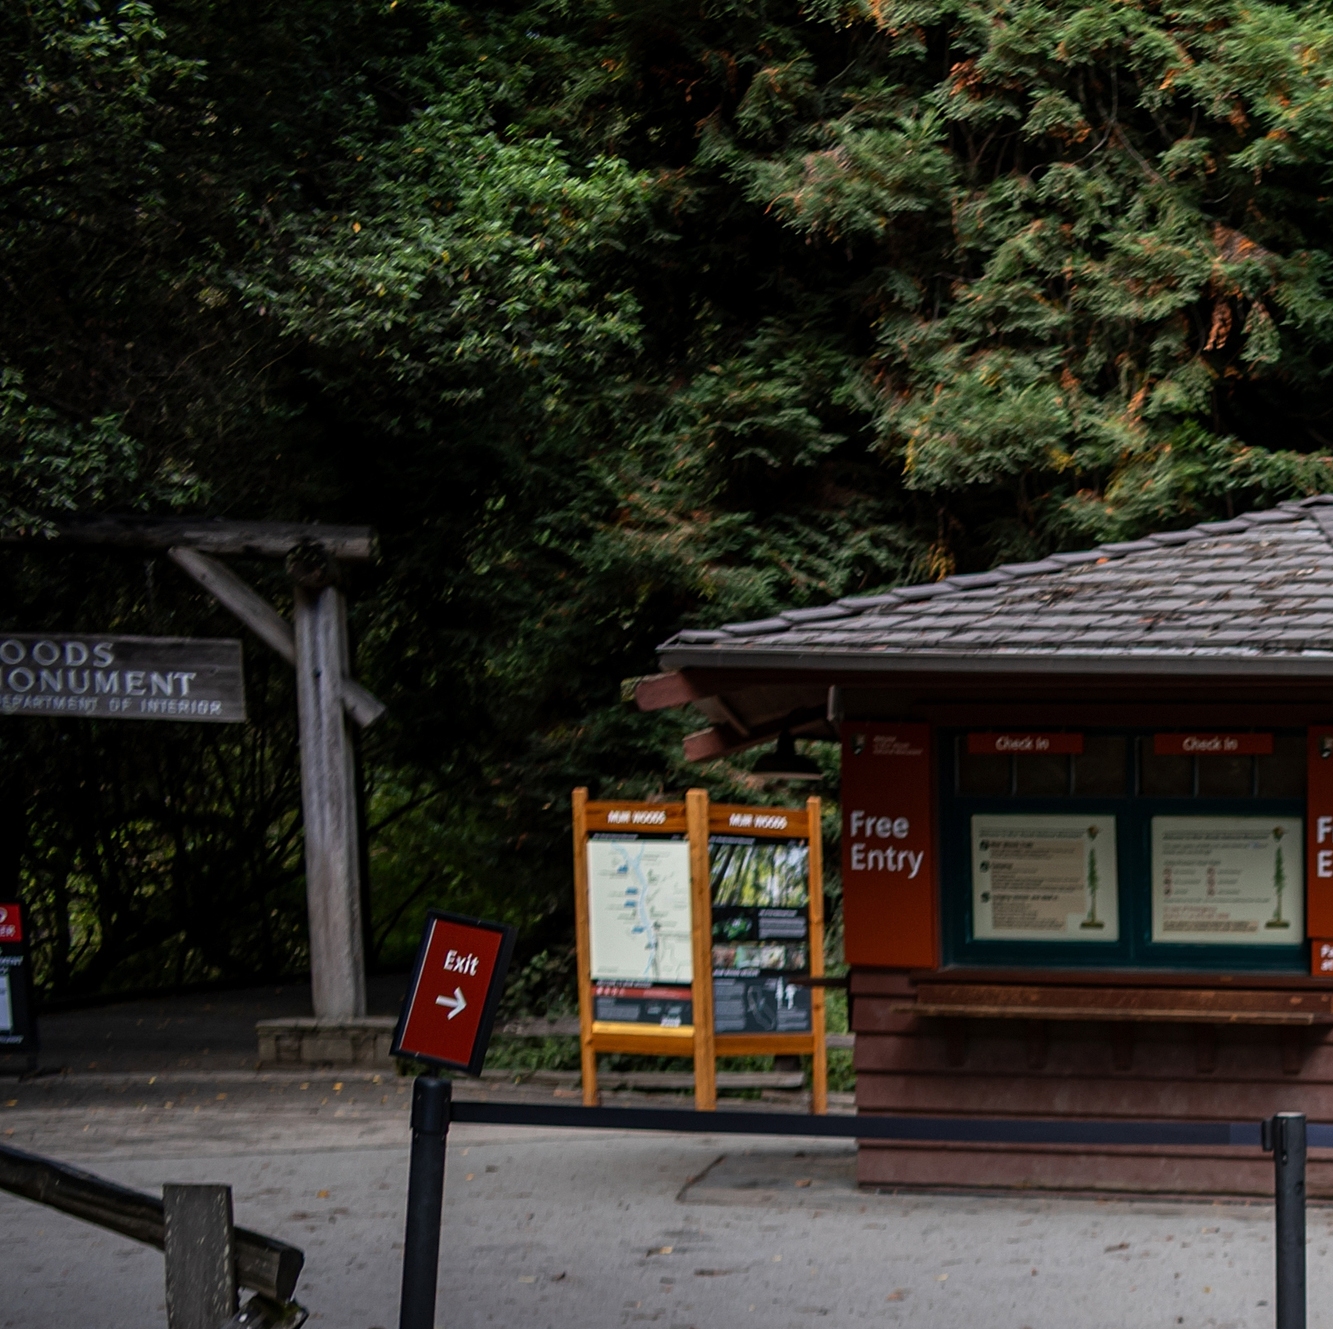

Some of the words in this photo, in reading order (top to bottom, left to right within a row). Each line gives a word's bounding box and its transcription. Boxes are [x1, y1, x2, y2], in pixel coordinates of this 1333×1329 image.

[0, 639, 114, 668] OODS
[0, 667, 196, 696] ONUMENT
[0, 695, 98, 714] EPARTMENT
[109, 697, 132, 712] OF
[140, 698, 222, 715] INTERIOR
[995, 735, 1034, 750] Check
[1182, 735, 1221, 751] Check
[850, 810, 909, 839] Free
[851, 843, 923, 879] Entry
[443, 949, 479, 976] Exit
